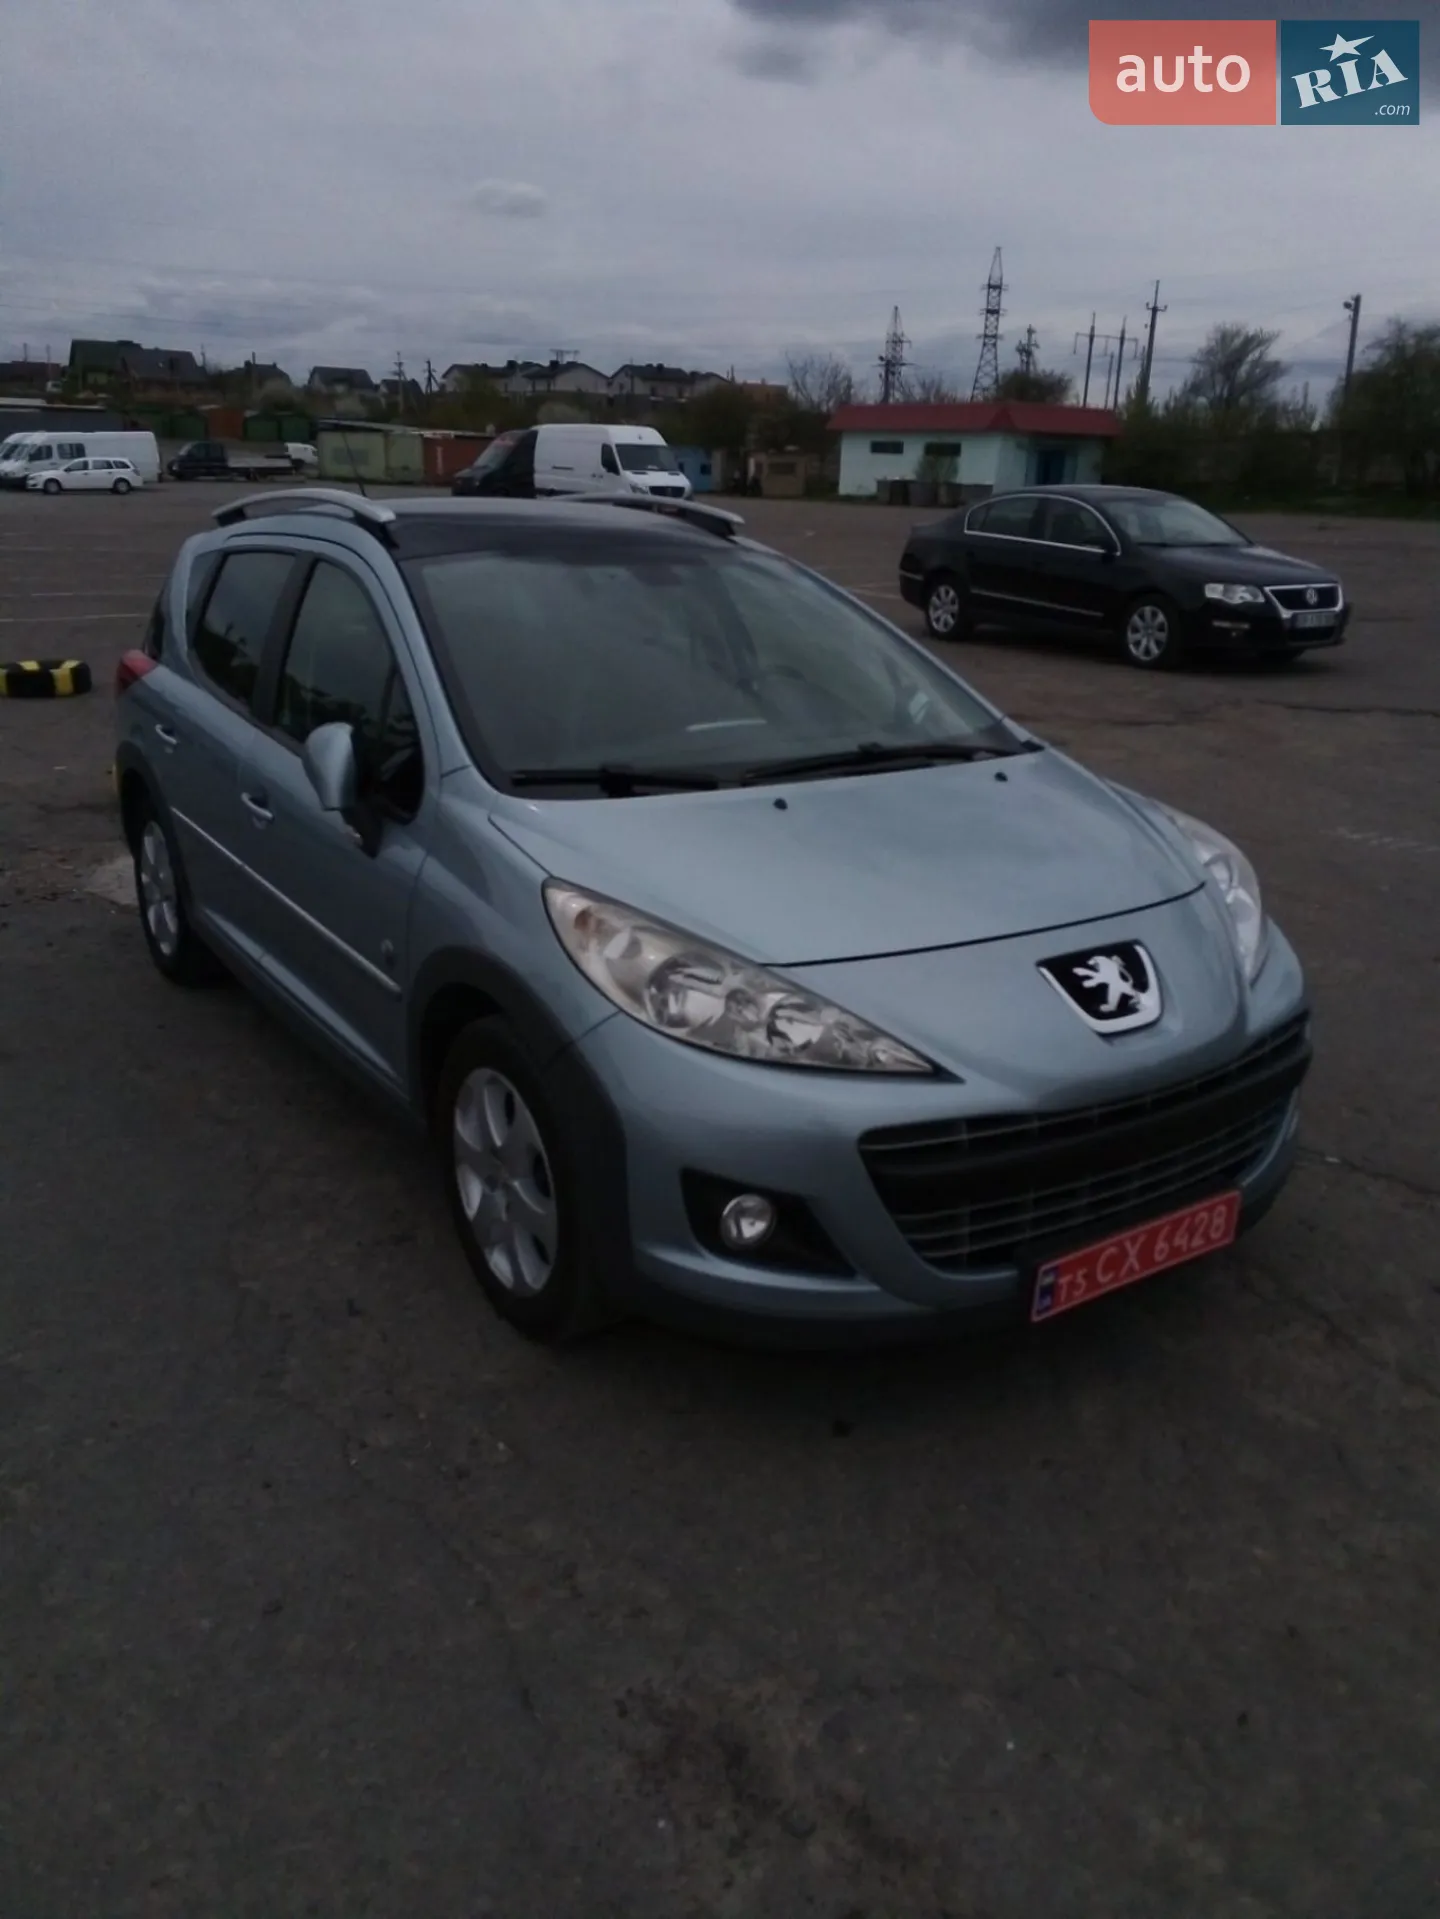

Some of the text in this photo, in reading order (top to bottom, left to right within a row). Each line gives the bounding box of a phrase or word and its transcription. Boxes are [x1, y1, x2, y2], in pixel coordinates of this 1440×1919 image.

[1057, 1203, 1228, 1303] T5 CX 6428
